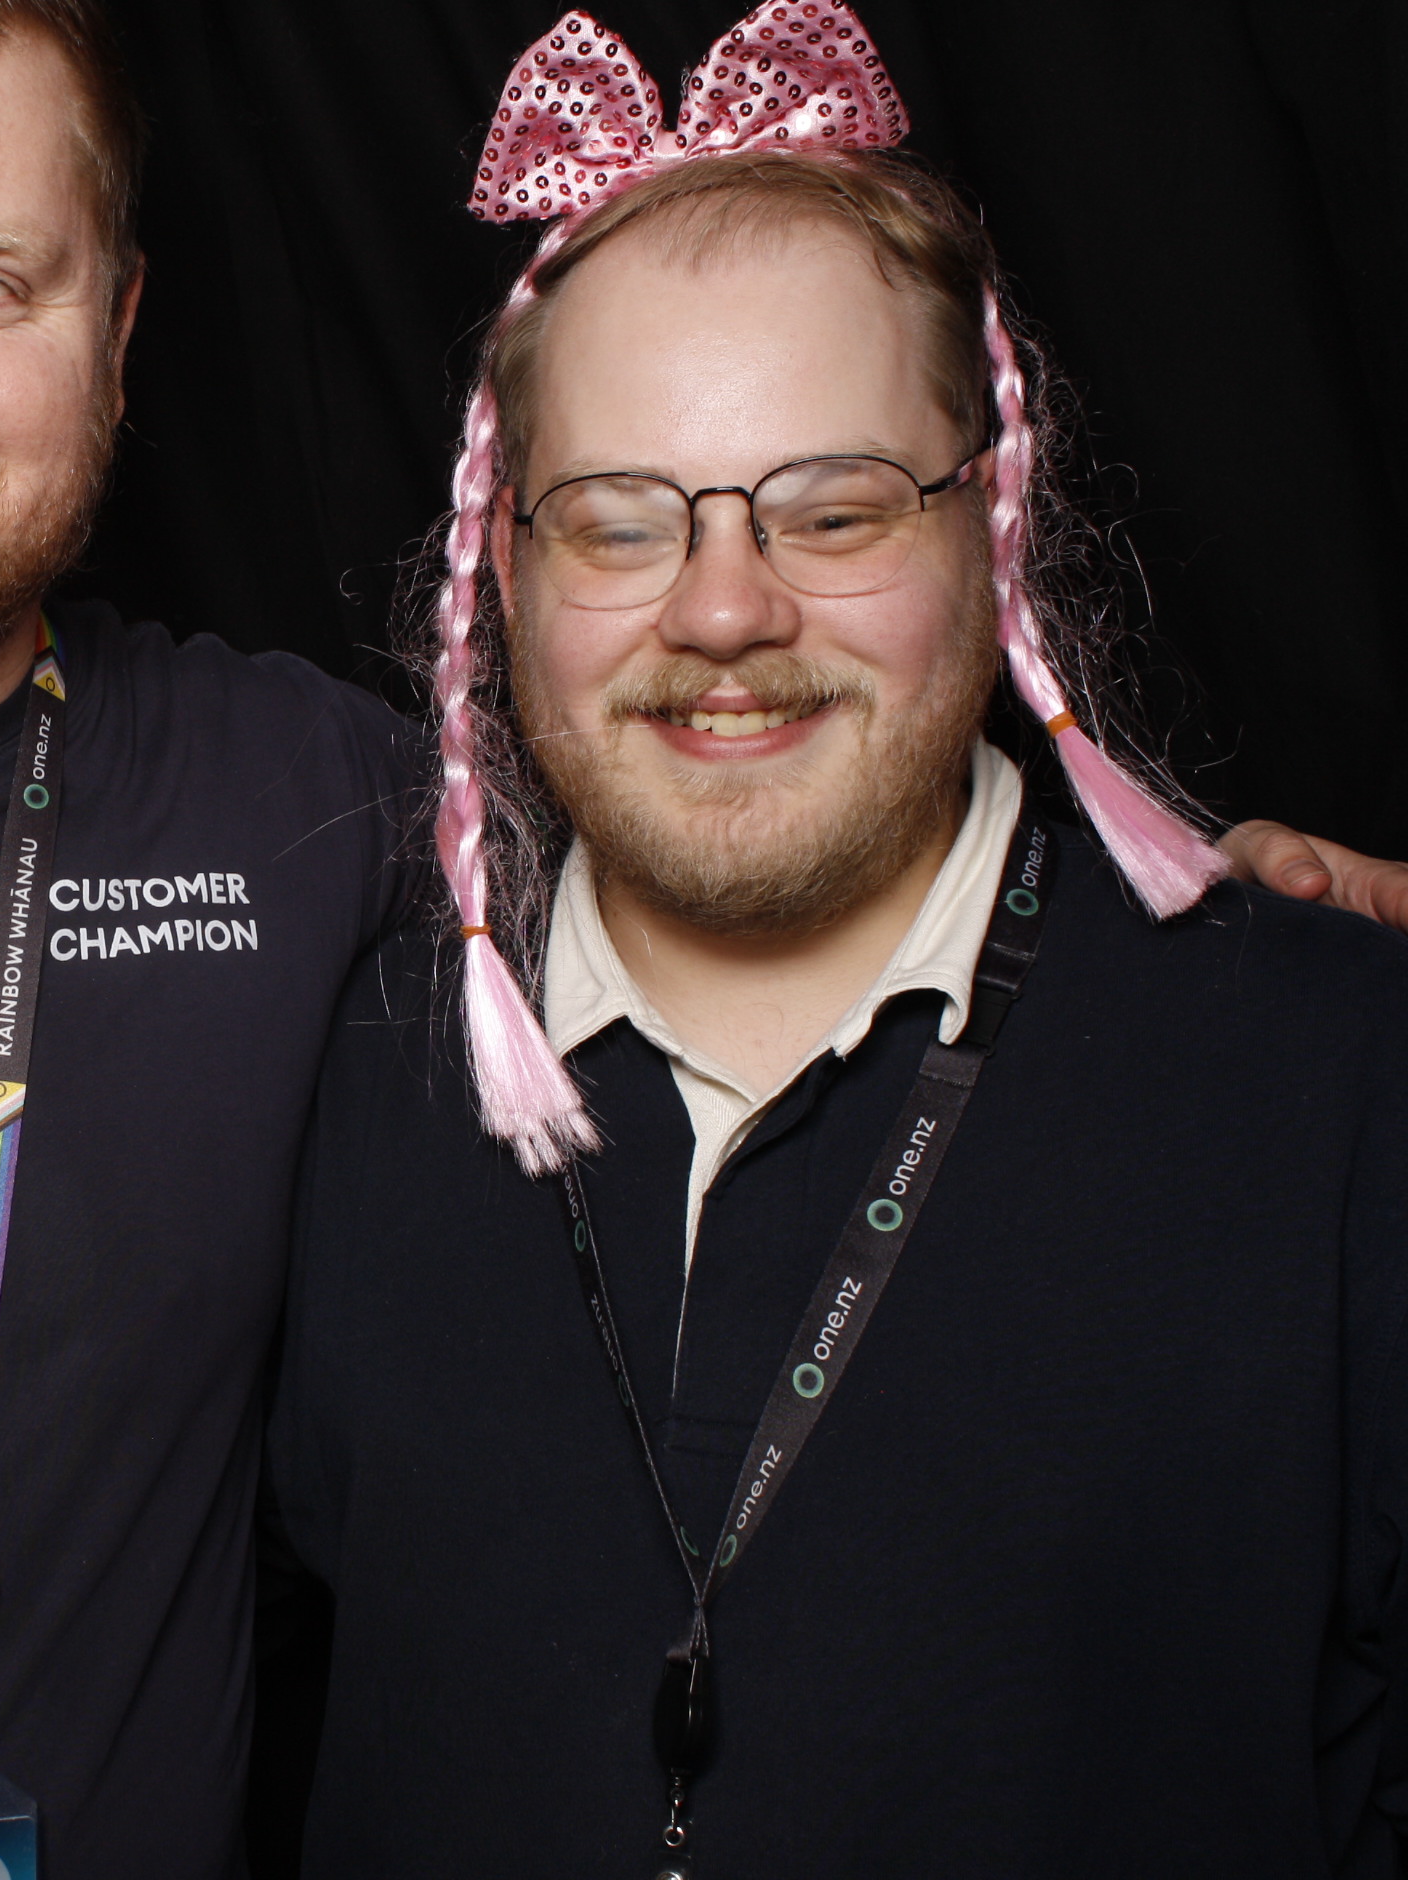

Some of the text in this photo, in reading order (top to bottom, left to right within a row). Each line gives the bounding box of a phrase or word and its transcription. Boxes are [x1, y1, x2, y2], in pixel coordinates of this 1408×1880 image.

[30, 714, 53, 780] one.nz
[7, 838, 38, 938] WHĀNAU
[48, 872, 250, 912] CUSTOMER
[1023, 825, 1047, 888] one.nz
[49, 919, 258, 962] CHAMPION
[887, 1116, 937, 1196] one.nz
[813, 1278, 863, 1360] one.nz
[736, 1444, 782, 1530] one.nz
